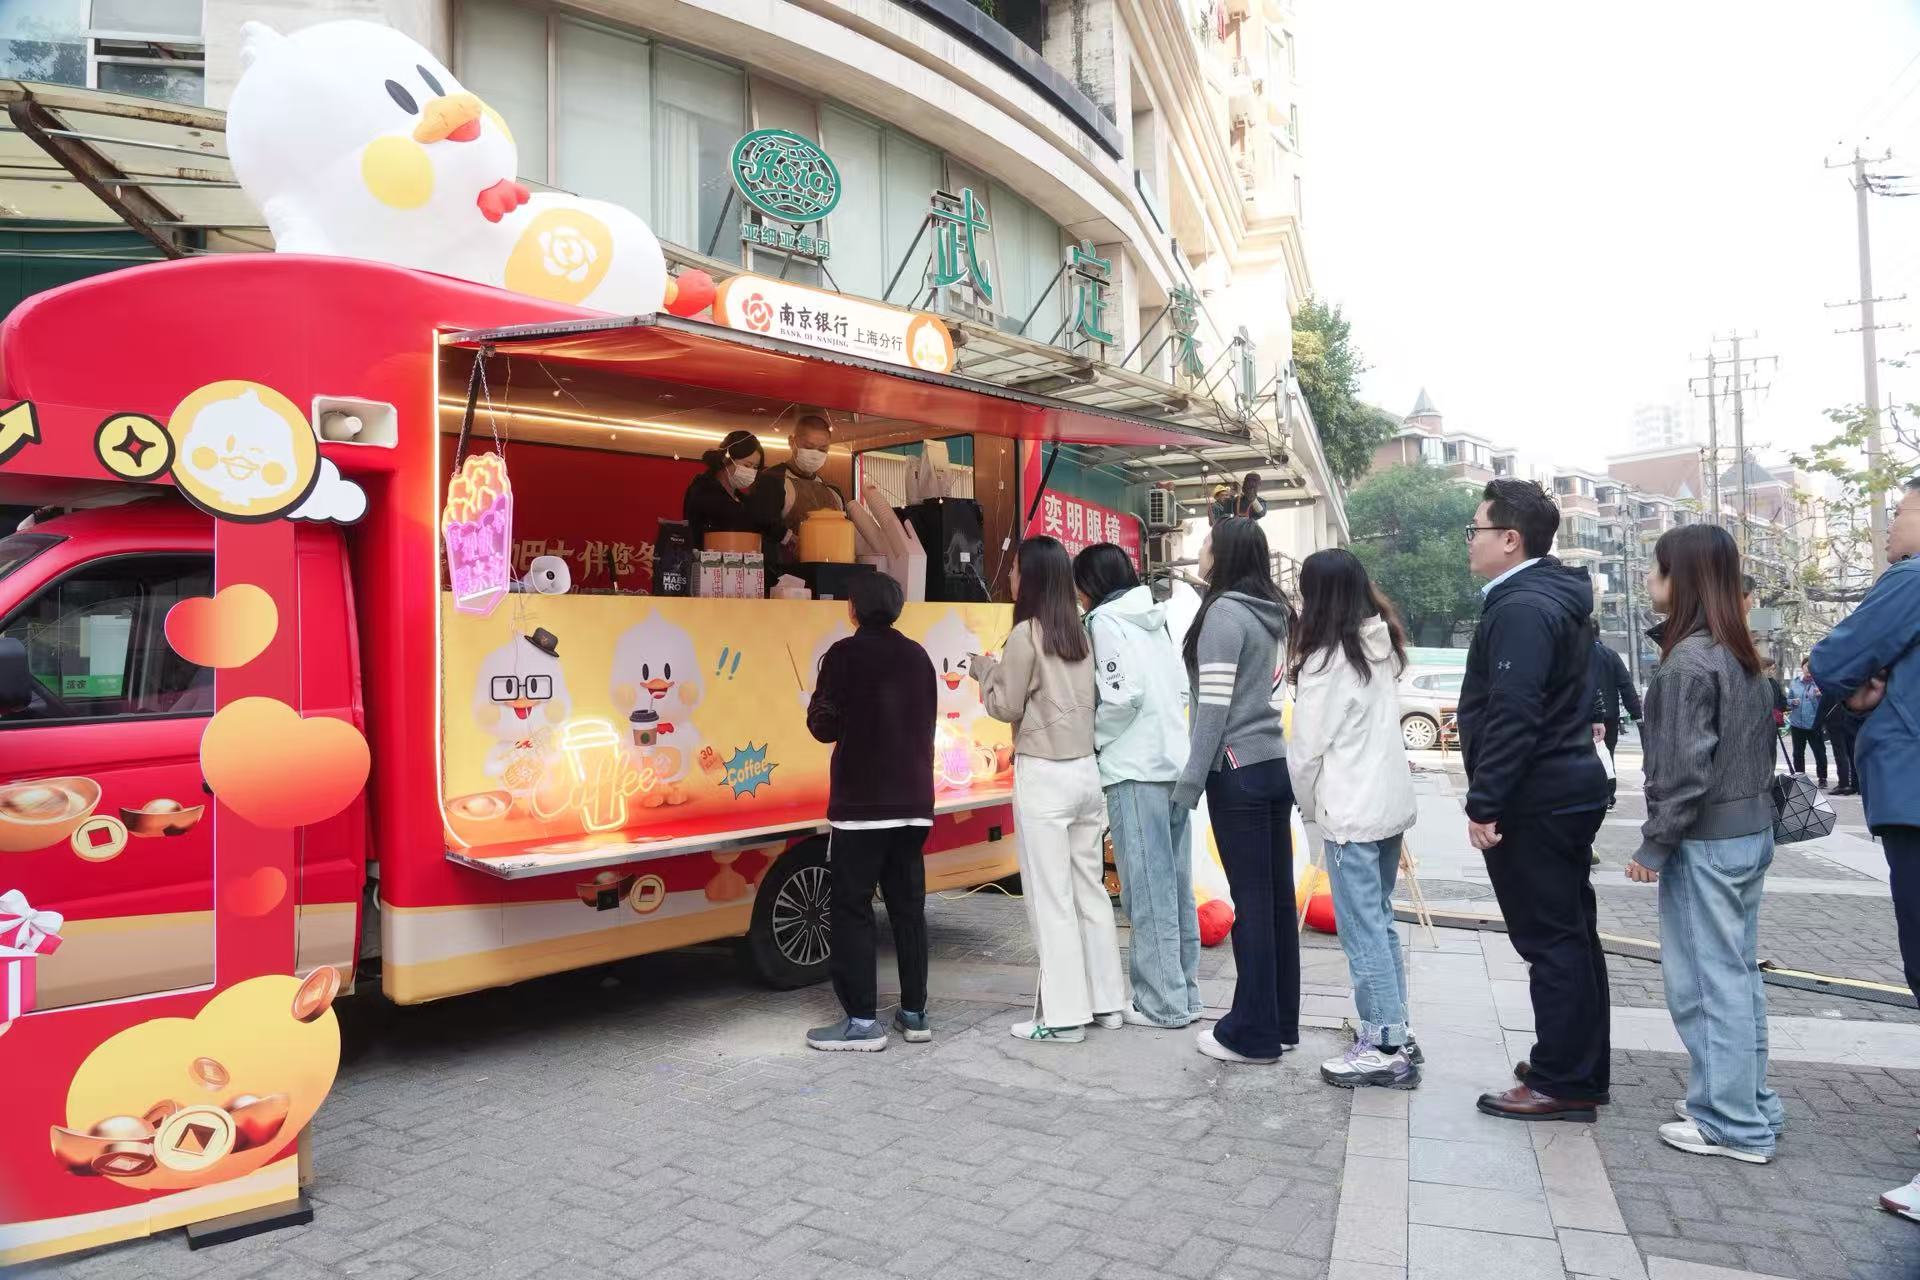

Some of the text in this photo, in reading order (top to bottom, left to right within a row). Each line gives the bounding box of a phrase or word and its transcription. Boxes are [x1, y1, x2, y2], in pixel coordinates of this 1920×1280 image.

[744, 149, 834, 197] Asia
[742, 223, 831, 259] 亚细亚集团
[779, 302, 849, 338] 南京银行
[780, 328, 802, 339] BANK
[816, 336, 849, 348] NANJING
[854, 327, 904, 351] 上海分行
[1044, 494, 1121, 545] 奕明眼镜
[663, 575, 687, 584] MAES
[664, 584, 682, 592] TRO
[728, 758, 769, 785] Coffee
[532, 751, 657, 824] Coffee
